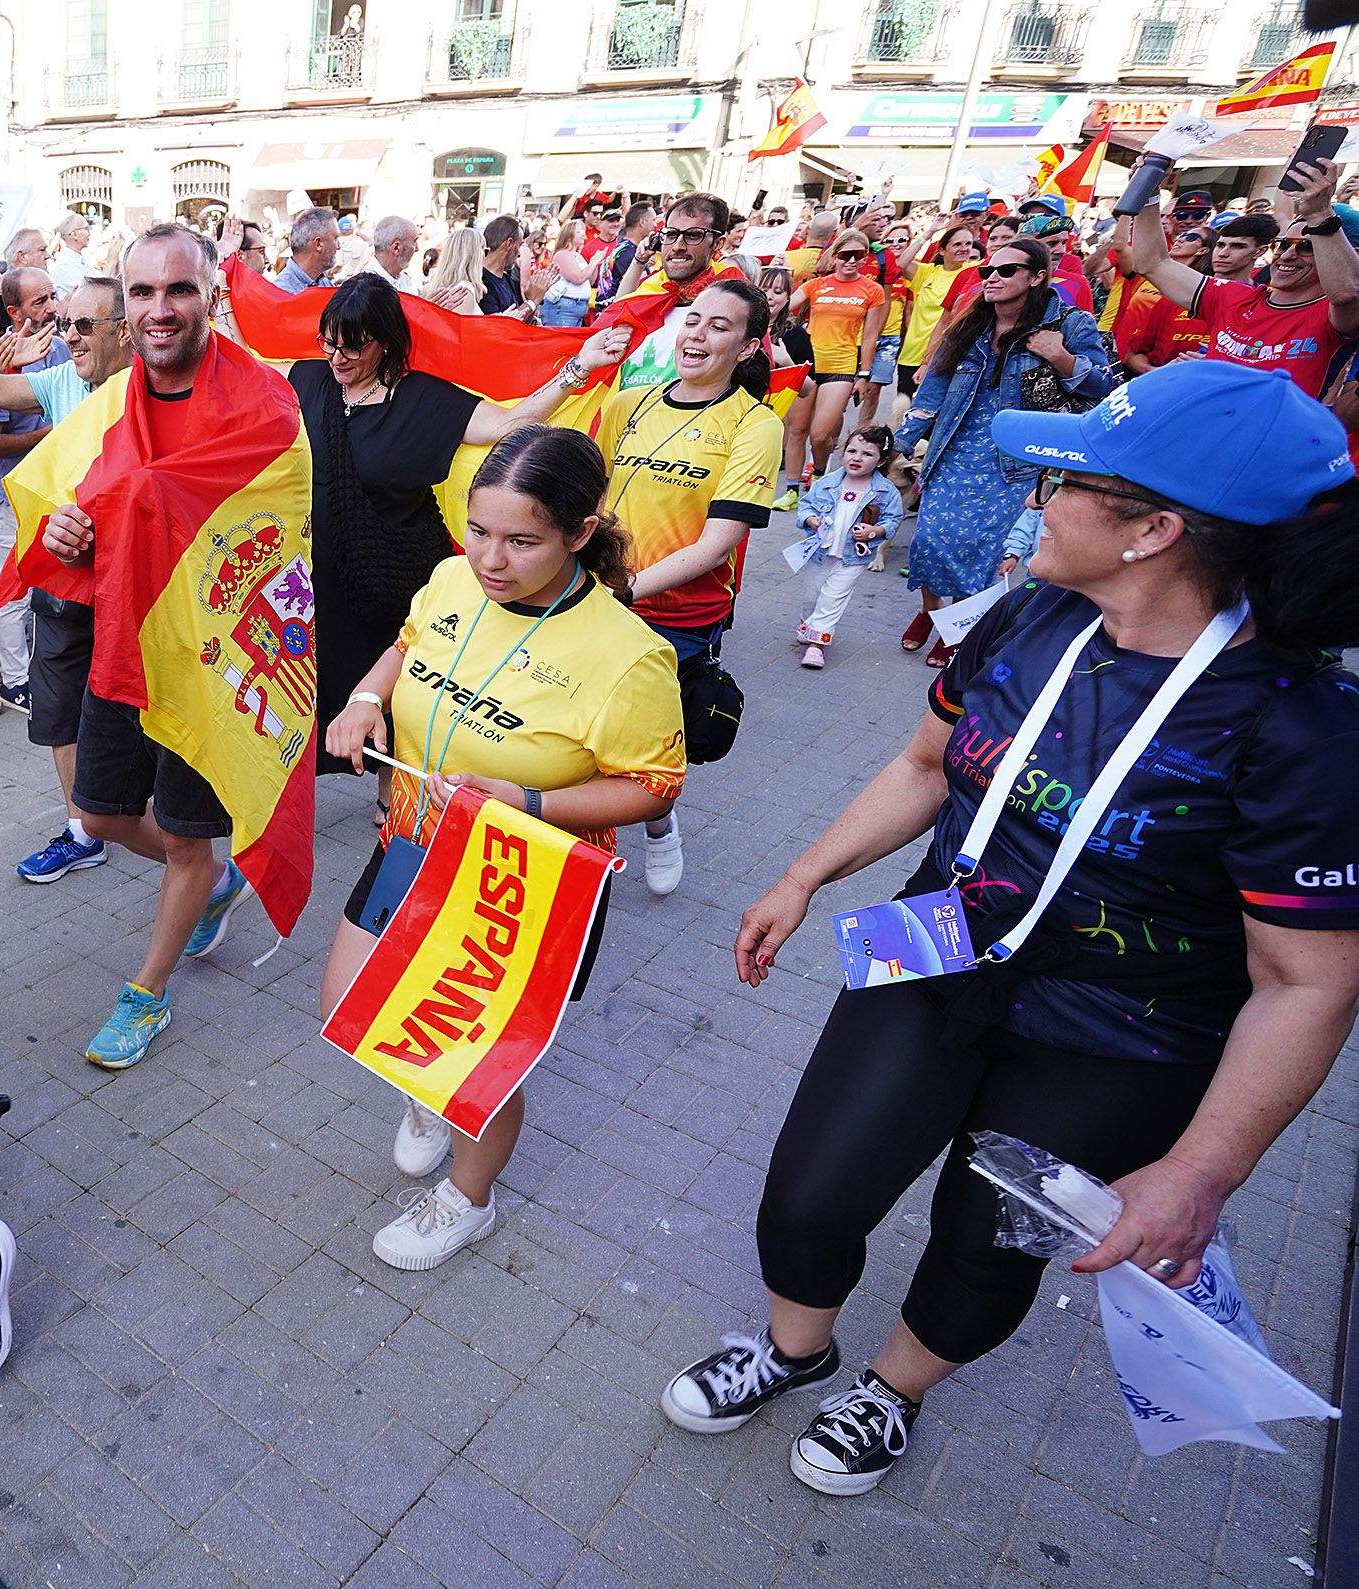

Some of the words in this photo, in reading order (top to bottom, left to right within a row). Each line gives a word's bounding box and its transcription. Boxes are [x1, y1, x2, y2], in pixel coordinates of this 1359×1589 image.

[621, 374, 664, 387] RIATLÓN
[614, 454, 711, 480] españa
[652, 474, 700, 490] TRIATLÓN
[536, 661, 570, 685] CESA
[409, 660, 525, 731] españa
[1037, 811, 1140, 861] 225
[1295, 863, 1359, 887] Gal
[373, 823, 528, 1068] ESPAÑA
